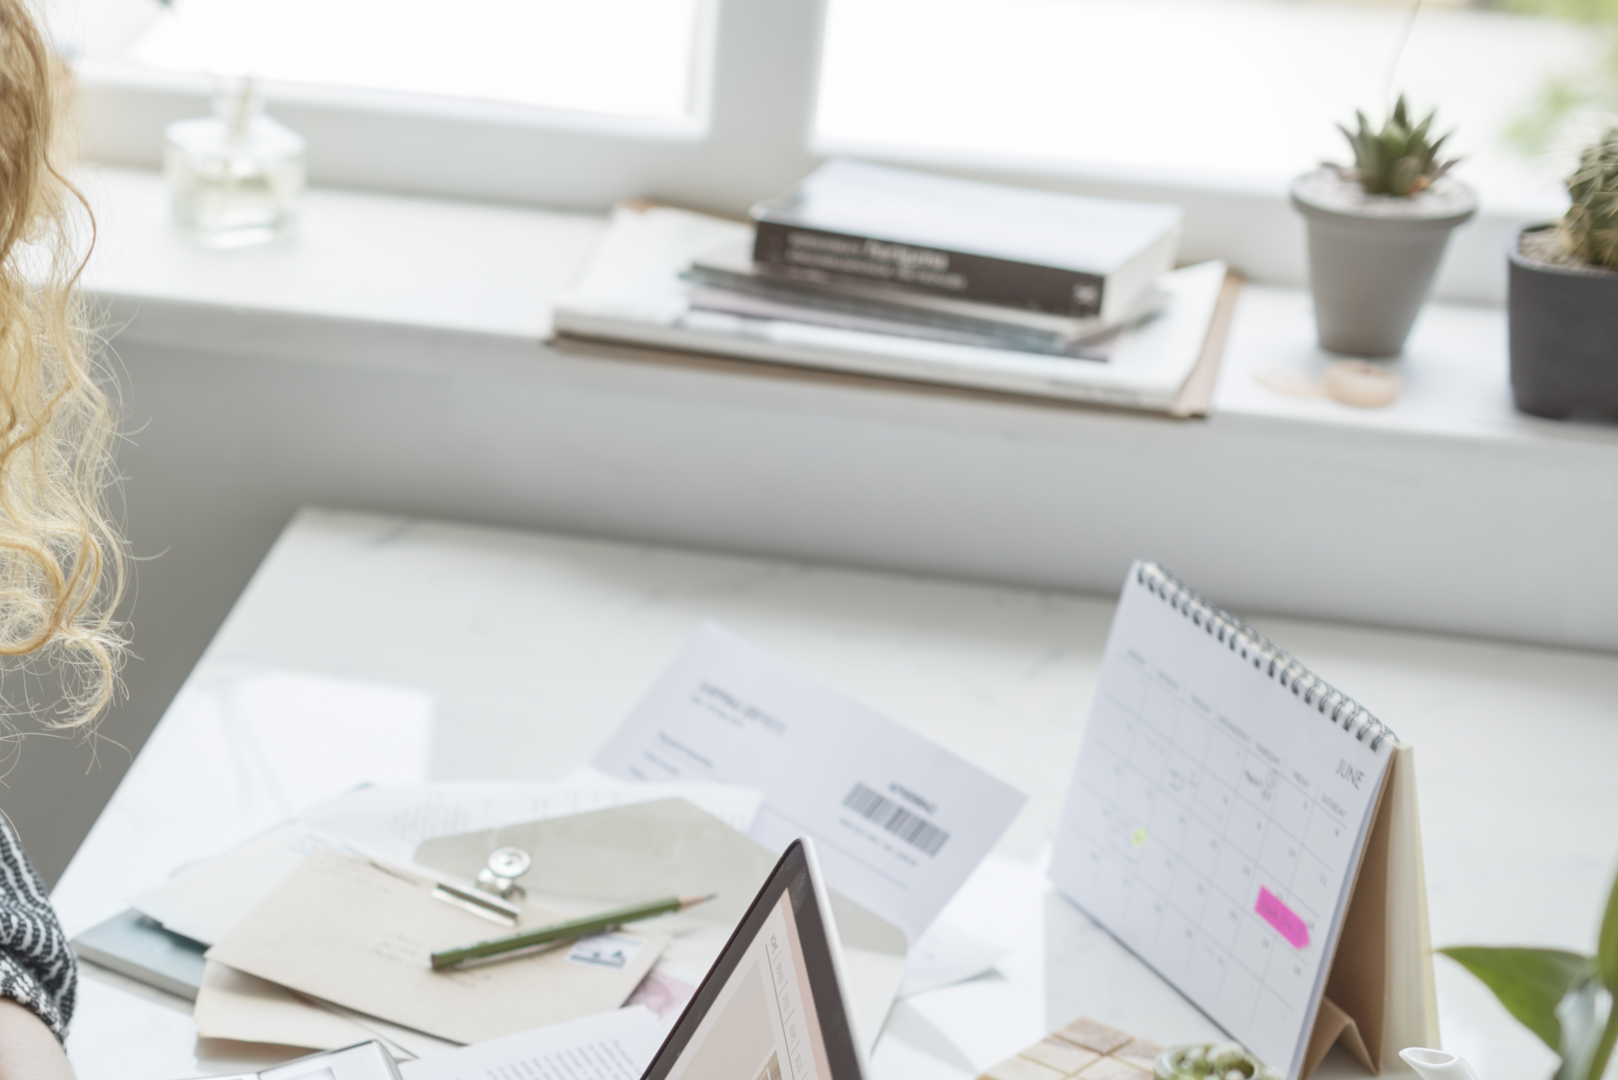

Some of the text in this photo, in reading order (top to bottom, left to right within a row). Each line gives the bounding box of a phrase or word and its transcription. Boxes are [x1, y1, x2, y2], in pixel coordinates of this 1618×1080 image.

[1336, 757, 1365, 790] JUNE
[770, 933, 778, 954] HOME
[794, 1053, 803, 1073] BLOG
